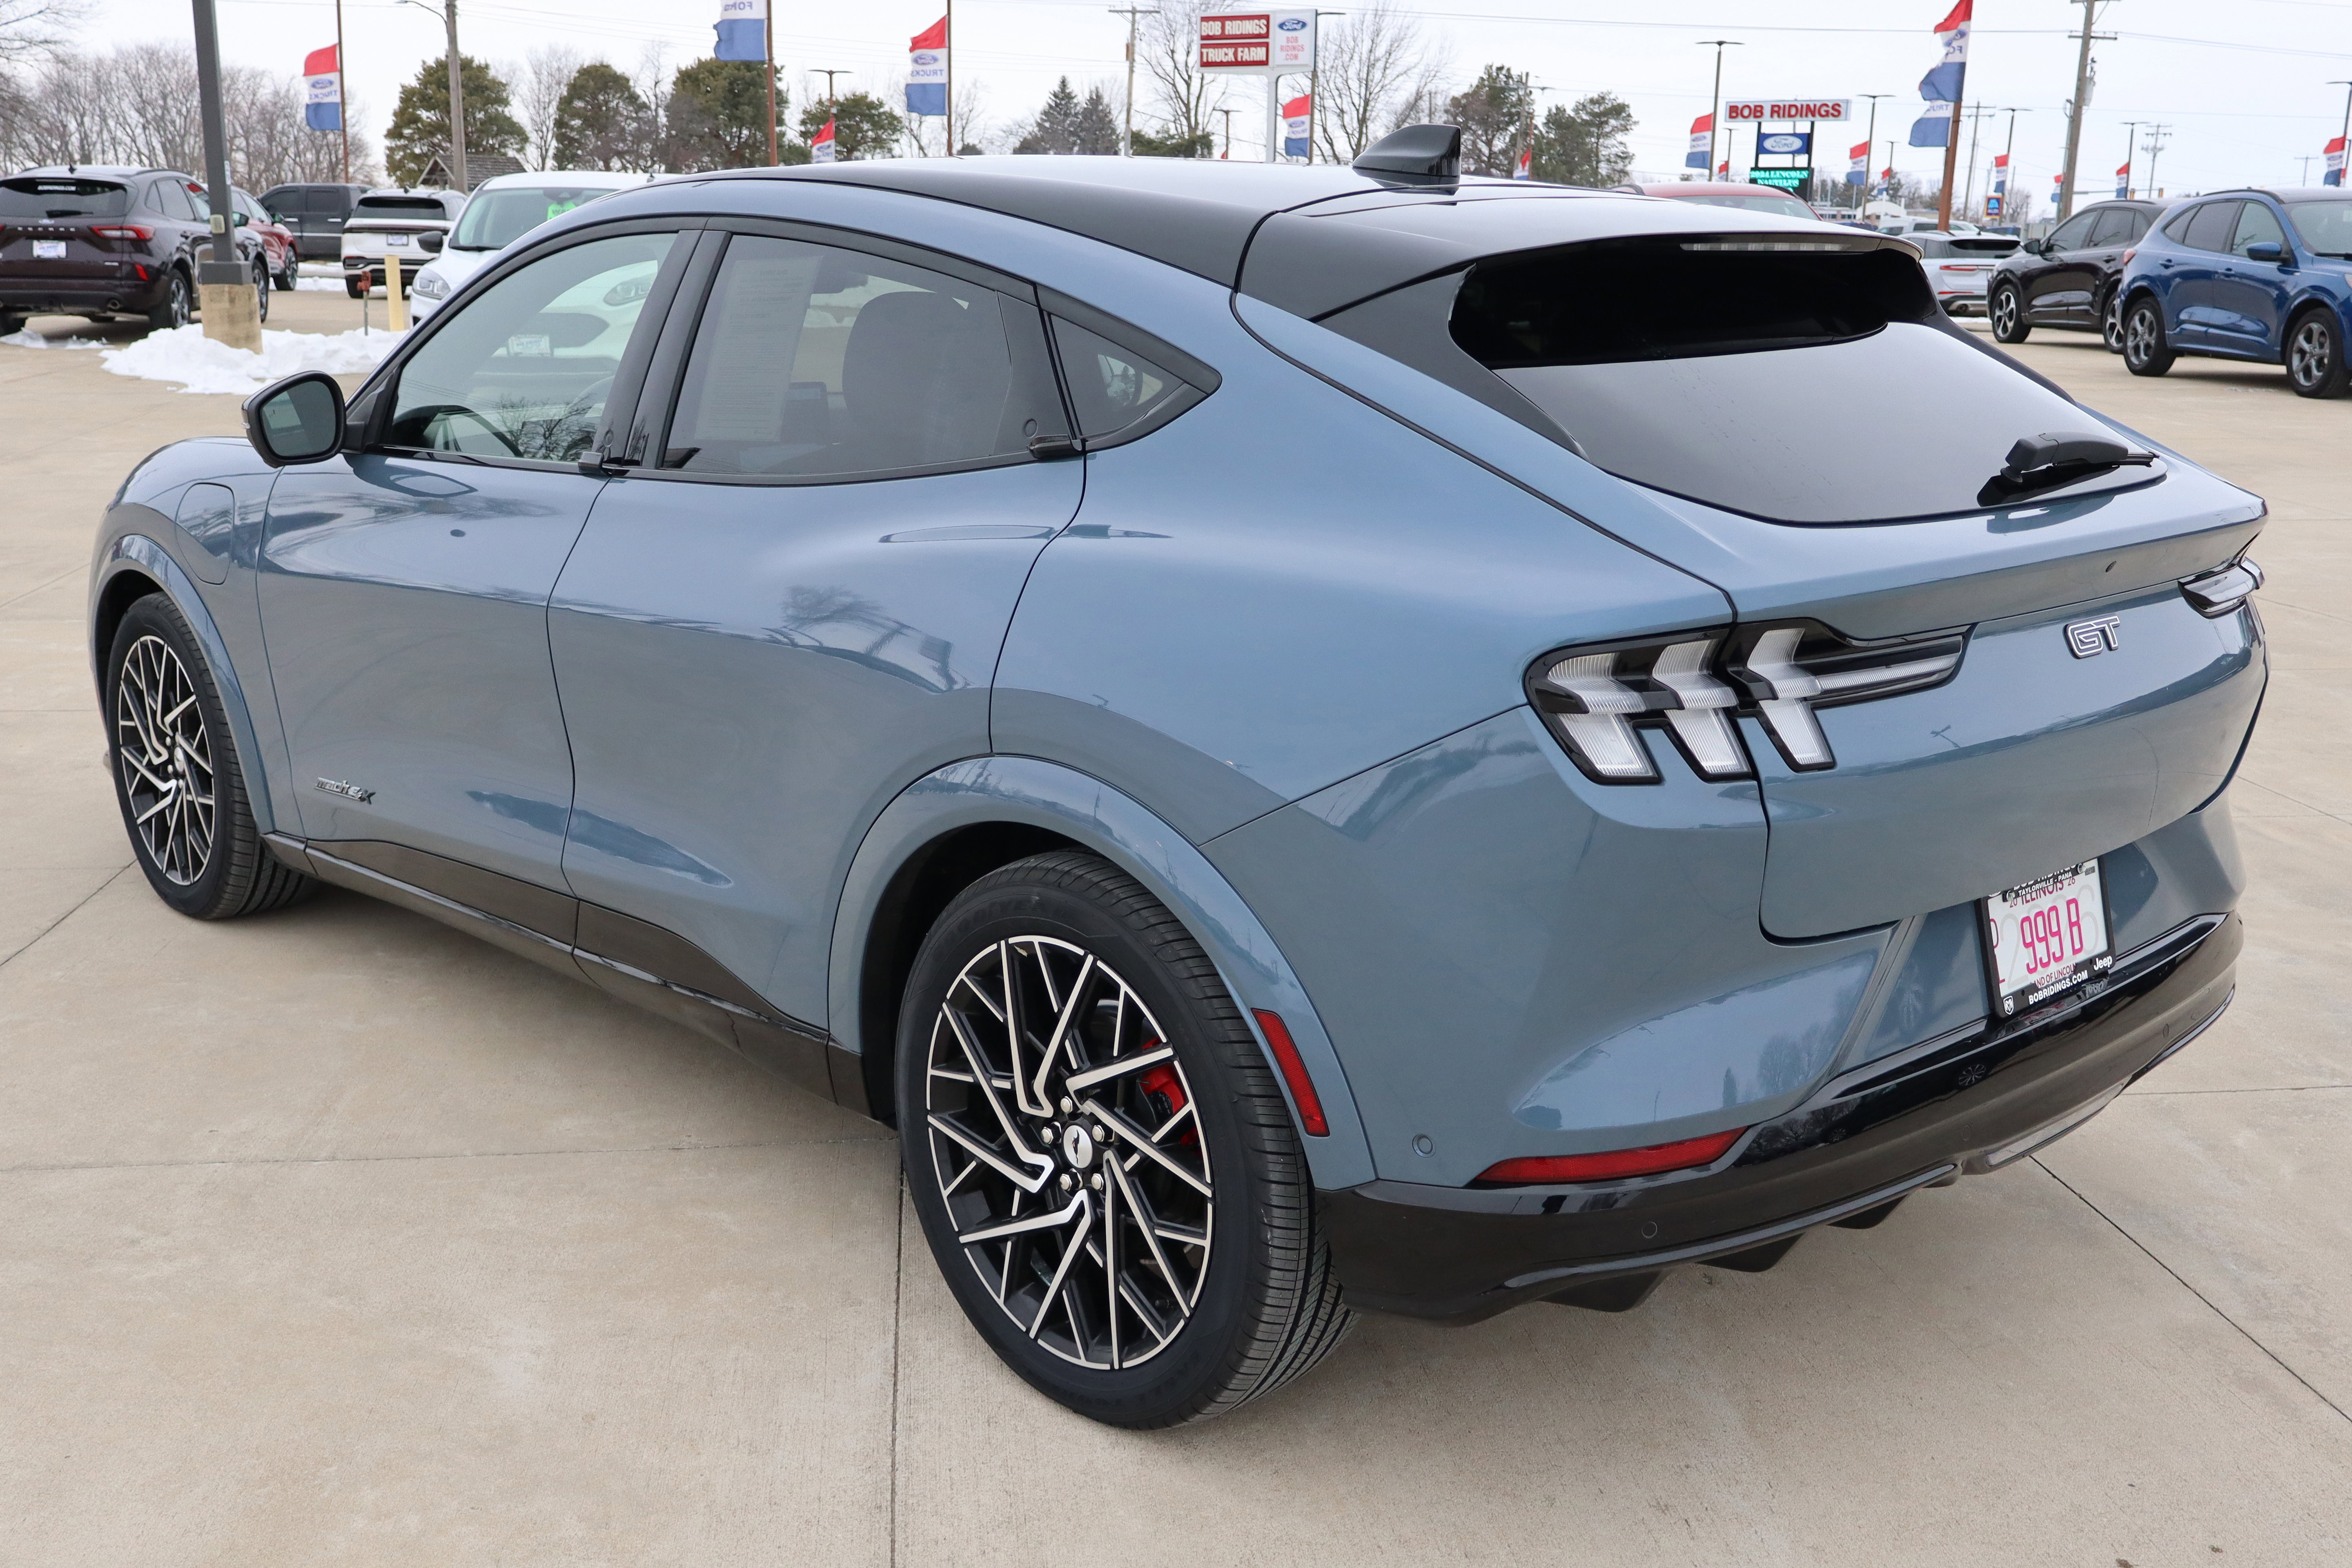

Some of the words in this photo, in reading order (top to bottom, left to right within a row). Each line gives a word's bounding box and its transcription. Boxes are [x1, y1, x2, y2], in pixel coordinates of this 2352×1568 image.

[1201, 21, 1222, 36] BOB
[1225, 19, 1267, 35] RIDINGS
[1282, 20, 1303, 30] Ford
[1201, 47, 1235, 62] TRUCK
[1237, 47, 1266, 61] FARM
[1728, 105, 1764, 119] BOB
[1770, 103, 1842, 118] RIDINGS
[1771, 138, 1795, 149] Ford
[2065, 614, 2120, 658] GT
[2018, 878, 2054, 897] TAYLORVILLE
[2058, 871, 2072, 882] PANA
[2067, 877, 2076, 886] 26
[2020, 904, 2064, 974] 999
[2066, 898, 2083, 956] B
[2093, 956, 2113, 971] Jeep
[2046, 973, 2053, 984] OF
[2054, 962, 2077, 981] LINCOLN
[2028, 970, 2088, 1005] BOBRIDINGS.COM
